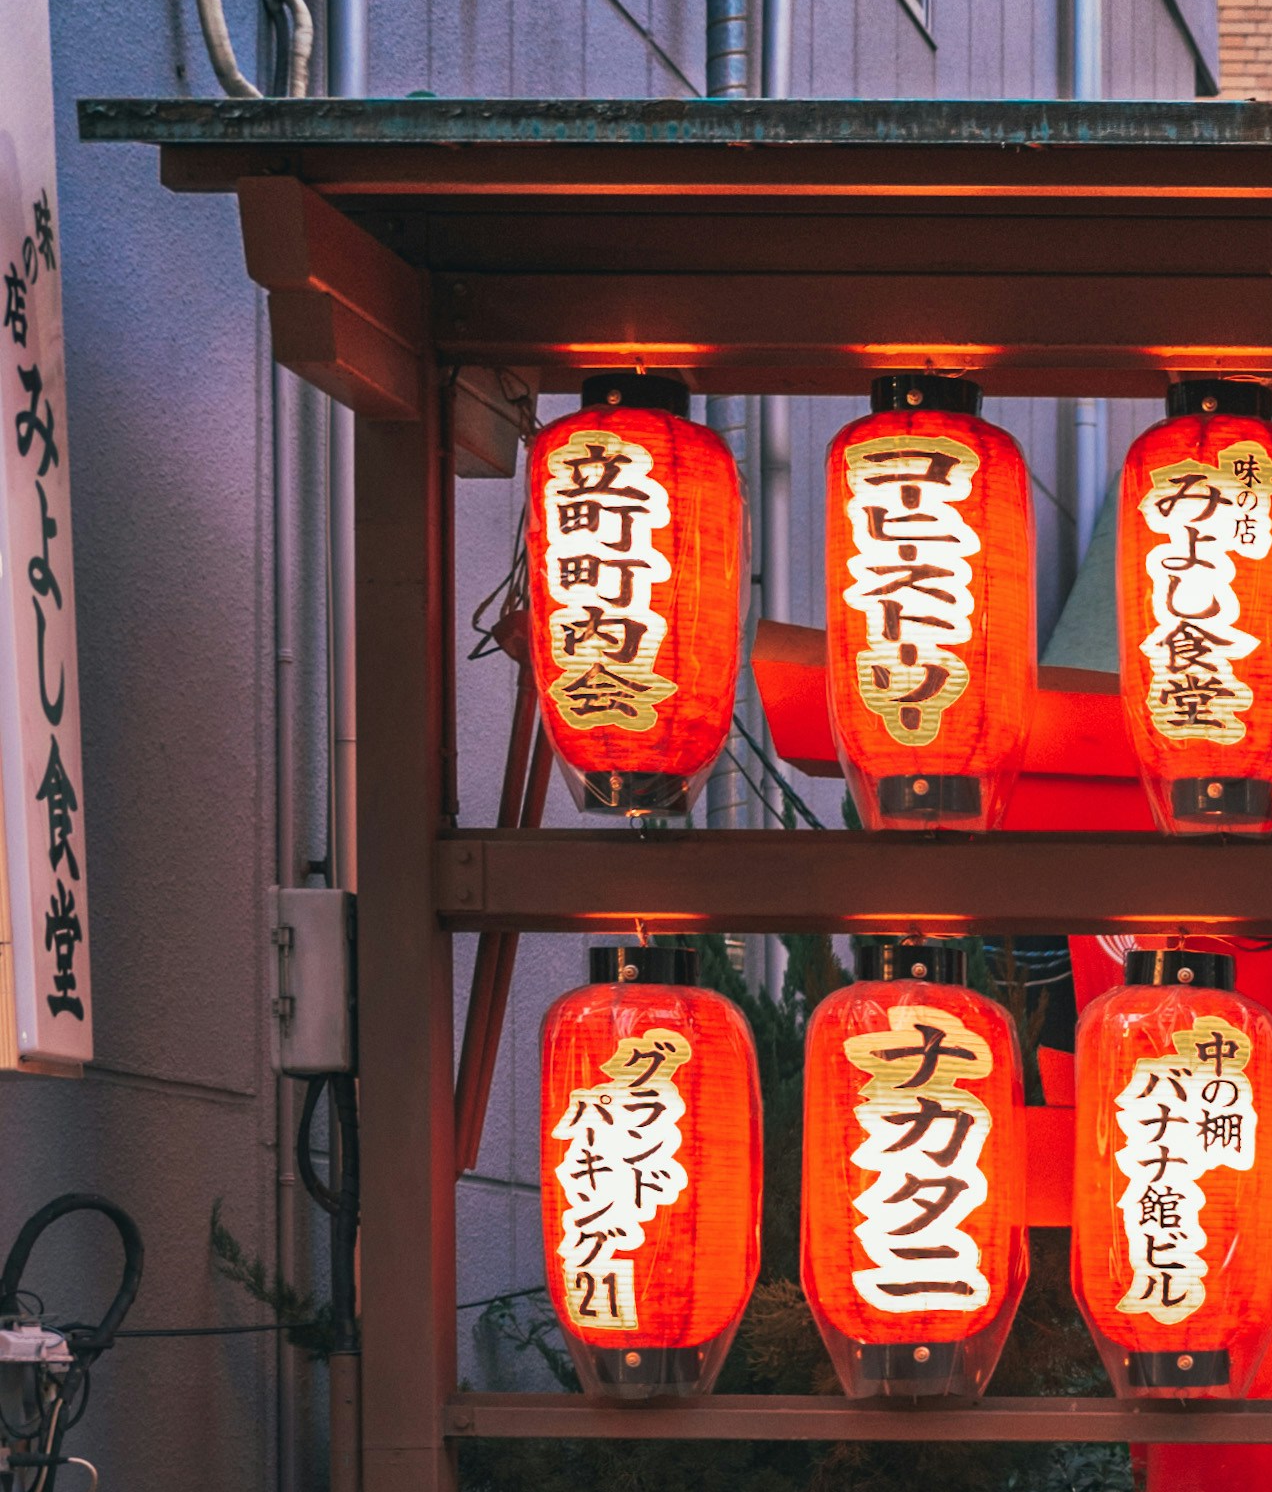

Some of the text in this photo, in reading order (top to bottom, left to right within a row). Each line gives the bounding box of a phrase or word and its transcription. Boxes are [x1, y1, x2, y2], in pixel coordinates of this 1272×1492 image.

[4, 188, 57, 347] 味の店
[559, 445, 655, 718] 立町町内会
[861, 451, 962, 730] コーヒーストーリー
[1153, 474, 1236, 730] みよし食堂
[1232, 453, 1265, 547] 味の店
[16, 363, 85, 1022] みよし食堂
[568, 1093, 628, 1320] パーキング21
[622, 1038, 674, 1210] グランド
[875, 1024, 979, 1298] ナカタニ
[1137, 1068, 1194, 1305] バナナ館ビル
[1196, 1031, 1245, 1153] 中の棚
